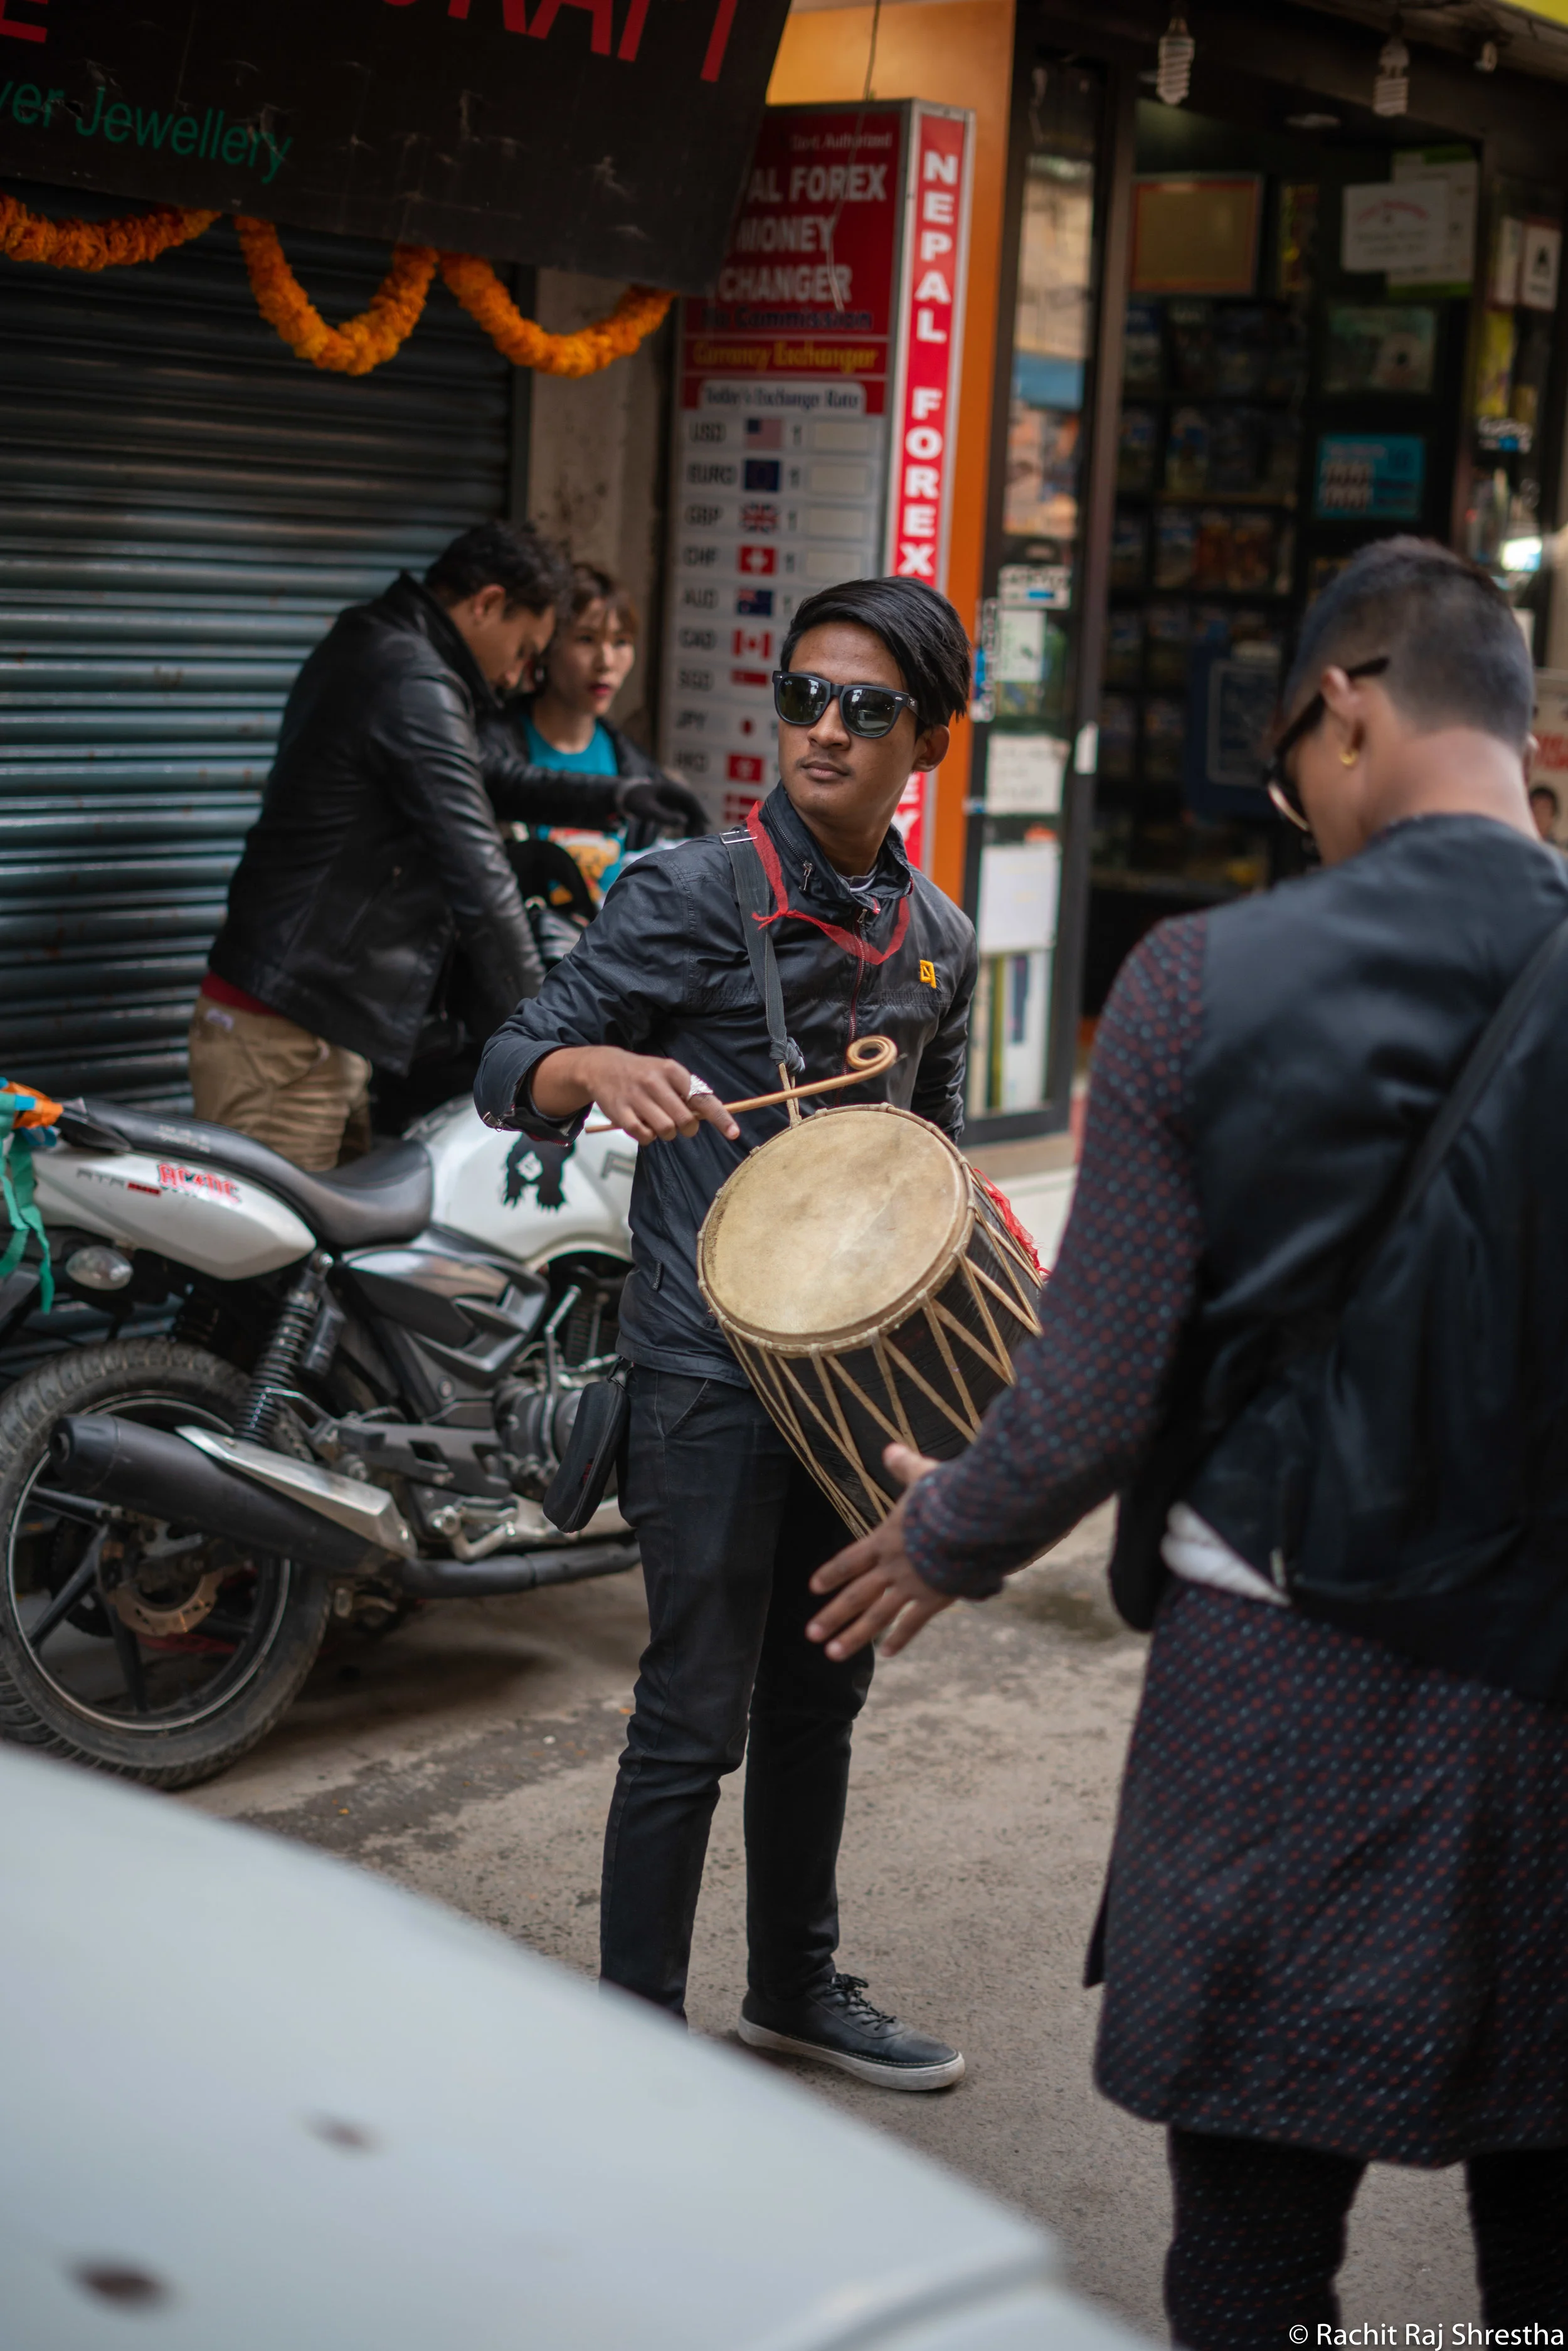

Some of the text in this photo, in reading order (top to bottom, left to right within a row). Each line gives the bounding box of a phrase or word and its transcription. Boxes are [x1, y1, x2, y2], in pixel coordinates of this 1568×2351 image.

[76, 85, 293, 184] Jewellery
[746, 163, 889, 203] AL FOREX
[736, 214, 838, 253] MONEY
[914, 151, 958, 343] NEPAL
[719, 263, 854, 303] CHANGER
[898, 386, 943, 576] FOREX
